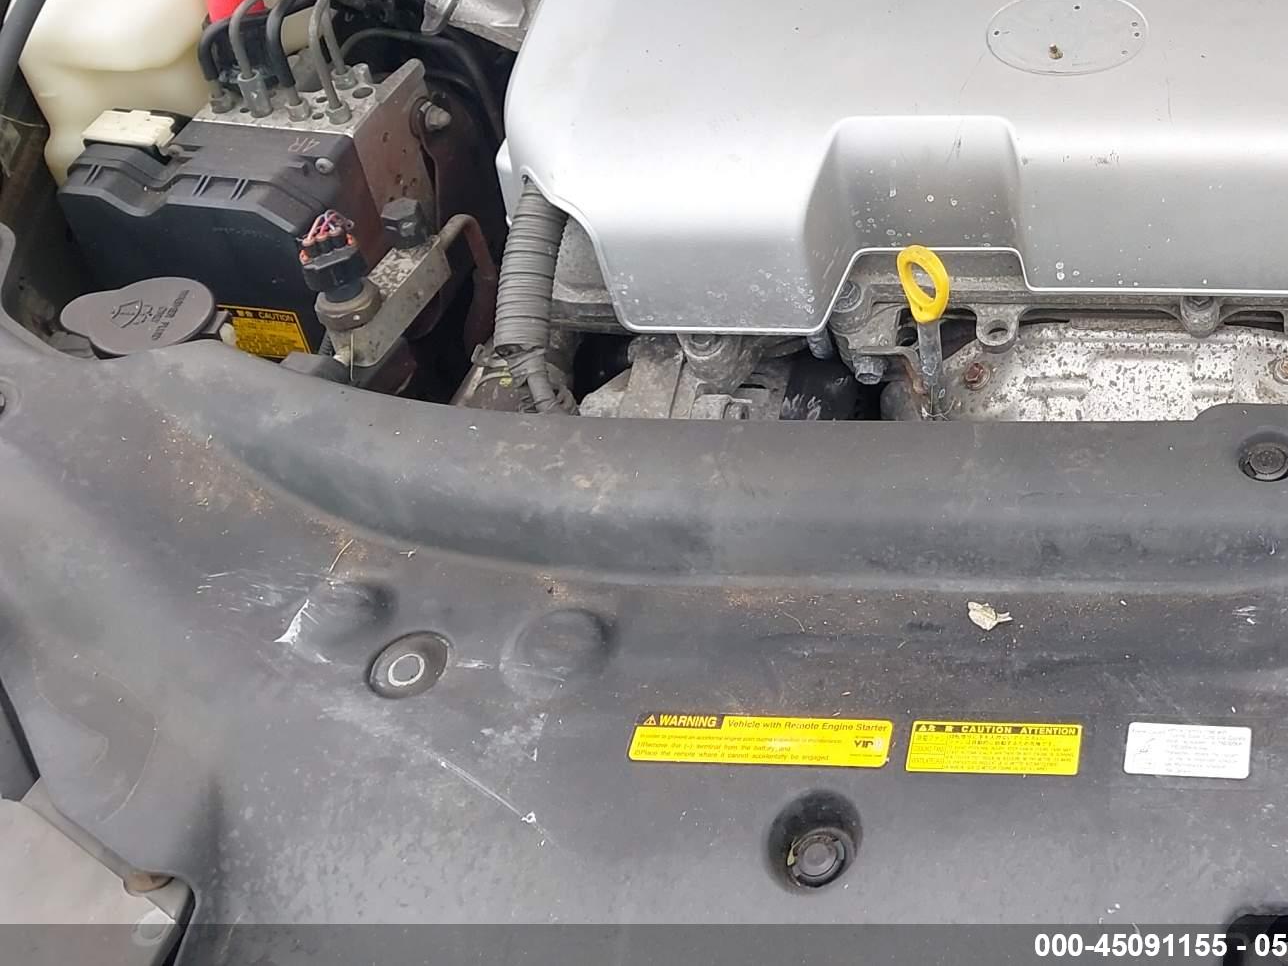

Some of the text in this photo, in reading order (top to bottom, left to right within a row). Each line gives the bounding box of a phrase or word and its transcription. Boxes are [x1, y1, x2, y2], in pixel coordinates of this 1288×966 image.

[258, 312, 294, 323] CAUTION
[659, 714, 718, 727] WARNING
[728, 719, 760, 728] Vehicle
[784, 721, 819, 730] Remote
[821, 722, 854, 732] Engine
[855, 723, 887, 732] Starter
[961, 725, 1013, 734] CAUTION
[1020, 726, 1076, 735] ATTENTION
[724, 743, 738, 751] from
[740, 743, 751, 751] the
